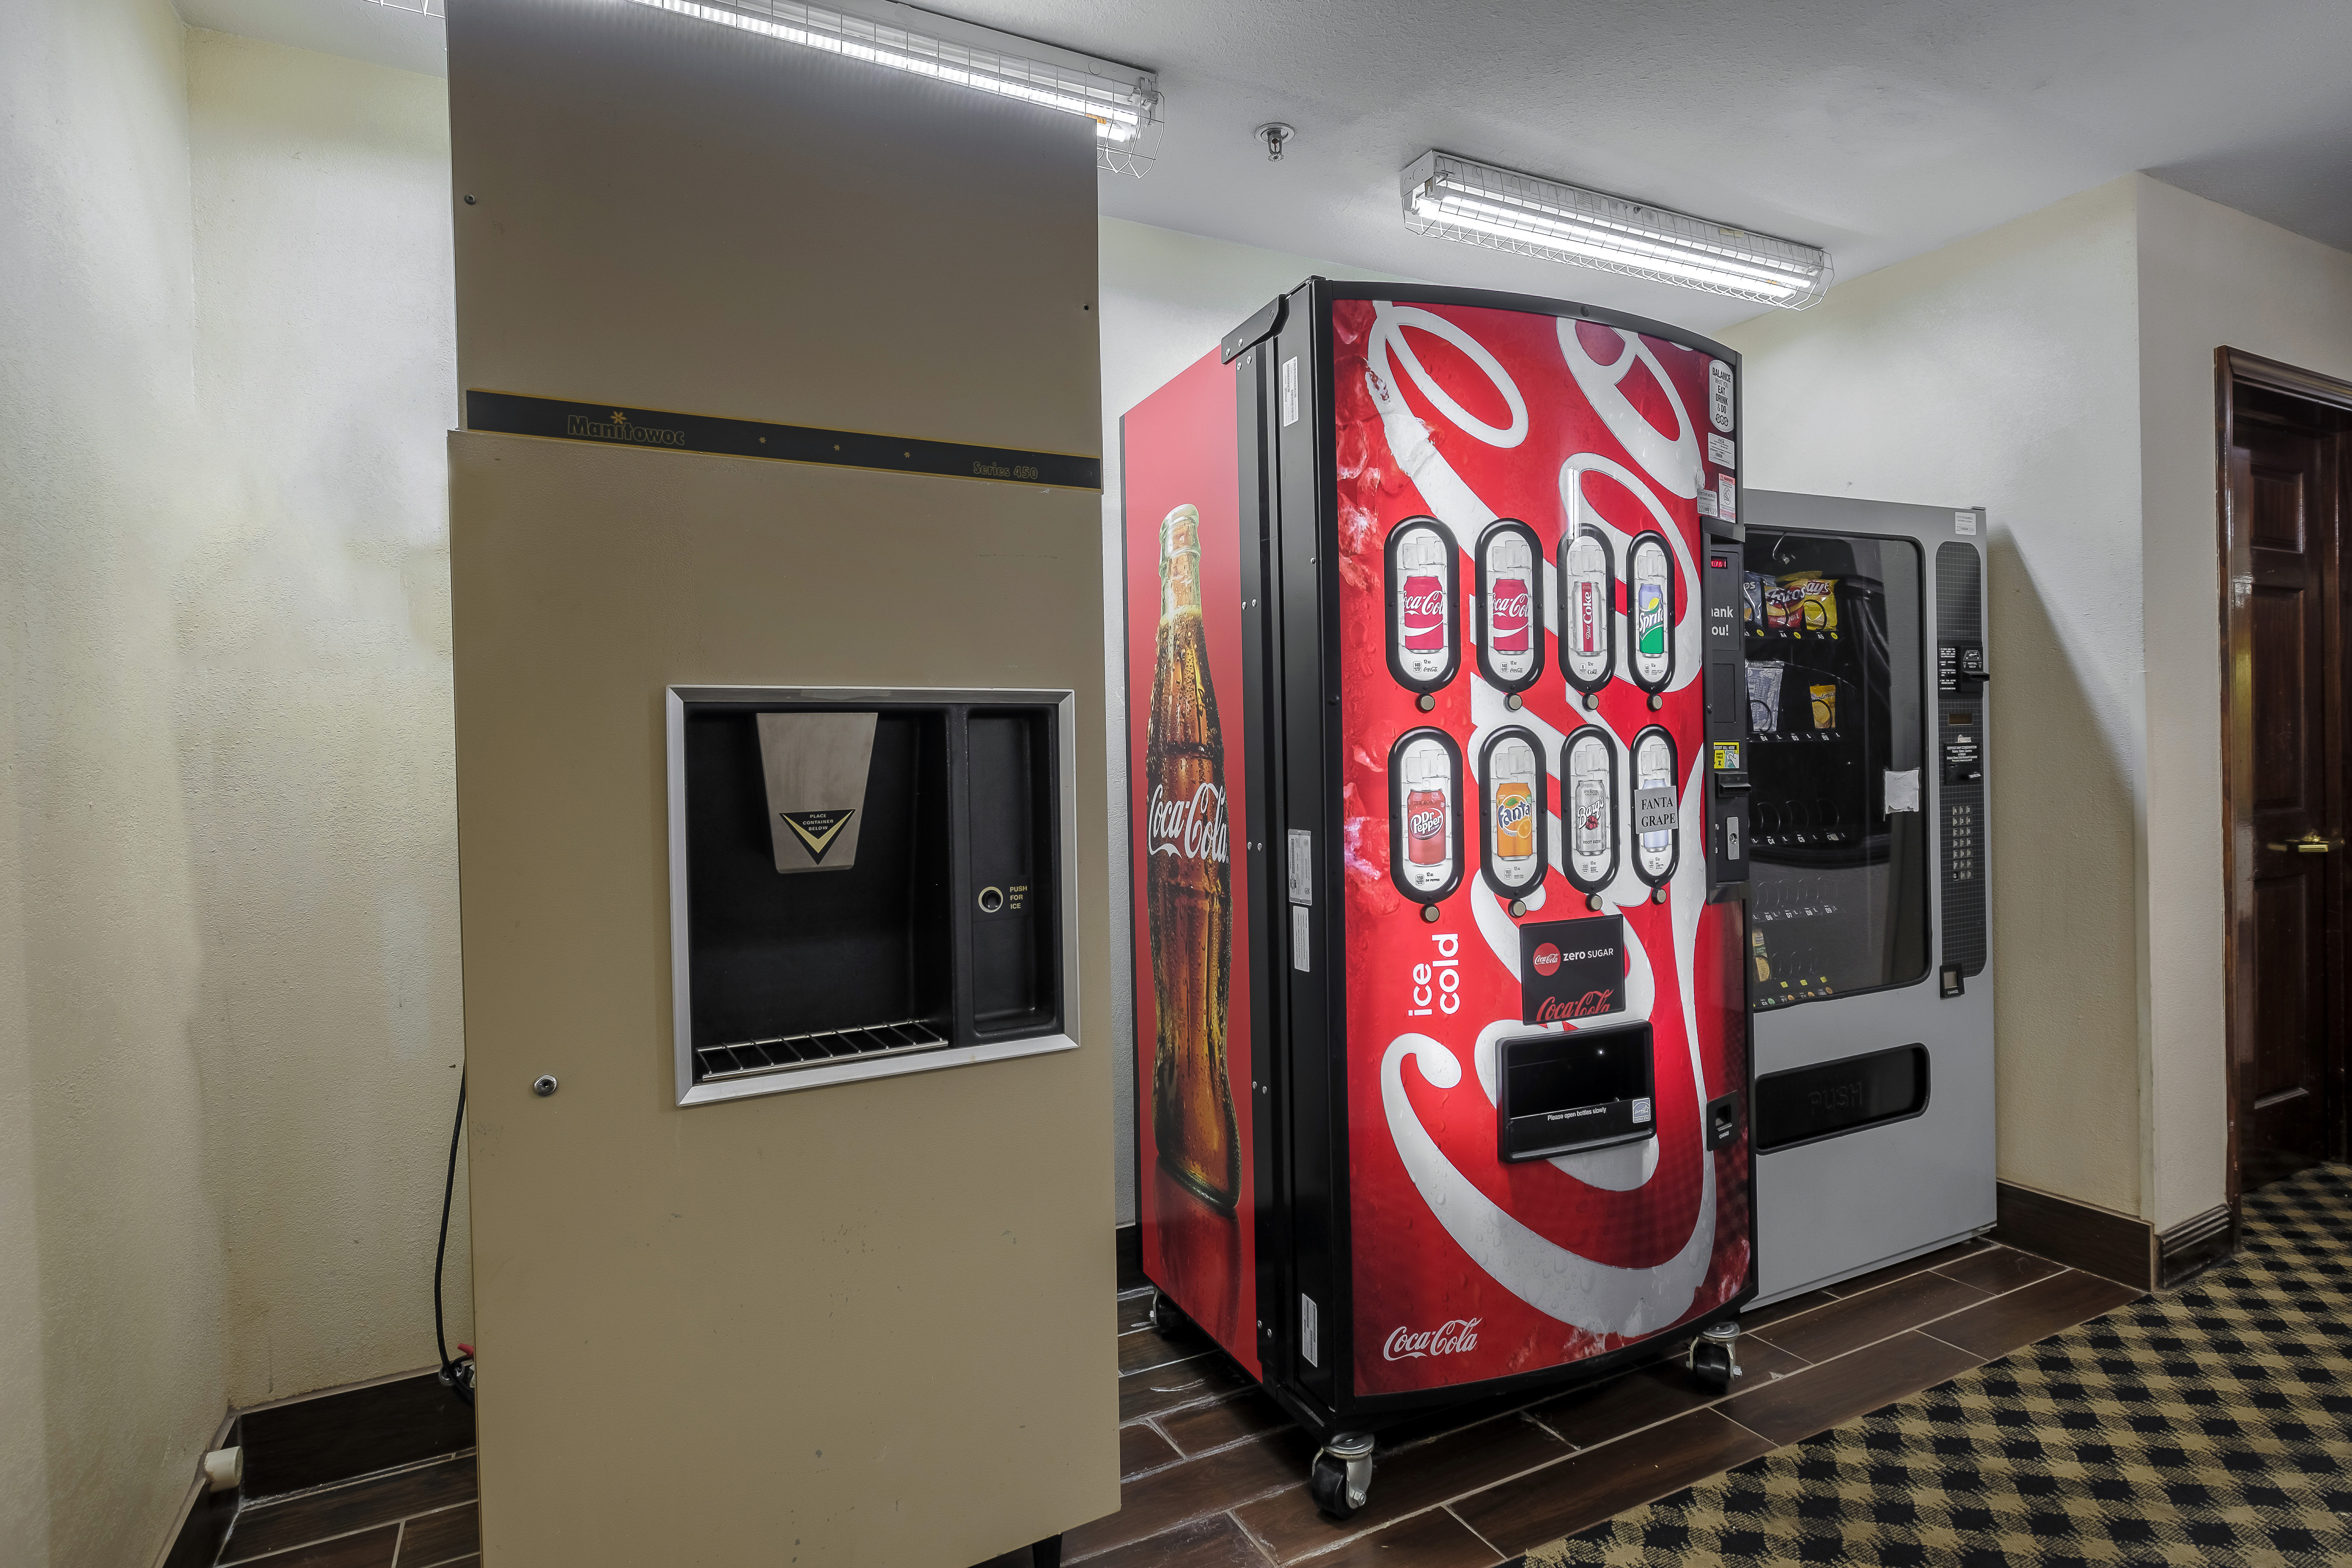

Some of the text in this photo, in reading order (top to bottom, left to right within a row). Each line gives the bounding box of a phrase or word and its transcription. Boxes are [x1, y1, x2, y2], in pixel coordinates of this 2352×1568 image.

[1712, 367, 1731, 383] BALANCE
[1715, 393, 1728, 406] DRINK
[1717, 403, 1726, 414] & DO
[568, 414, 684, 445] Manitowoc
[974, 461, 1038, 479] Series 450
[1583, 591, 1592, 624] Coke
[1639, 604, 1664, 634] Sprite
[1711, 624, 1729, 636] ou!
[1421, 811, 1435, 824] Dr
[1498, 800, 1531, 829] Fanta
[1578, 796, 1604, 829] Barq's
[1641, 796, 1674, 811] FANTA
[1148, 782, 1227, 863] Coca-Cola
[1410, 814, 1442, 835] Pepper
[1641, 813, 1675, 827] GRAPE
[1534, 948, 1613, 965] Coca-Cola zero SUGAR
[1432, 933, 1460, 1014] cold
[1408, 963, 1432, 1016] ice
[1536, 989, 1614, 1022] Coca-Cola
[1808, 1081, 1863, 1115] PUSH
[1383, 1317, 1483, 1361] Coca-Cola
